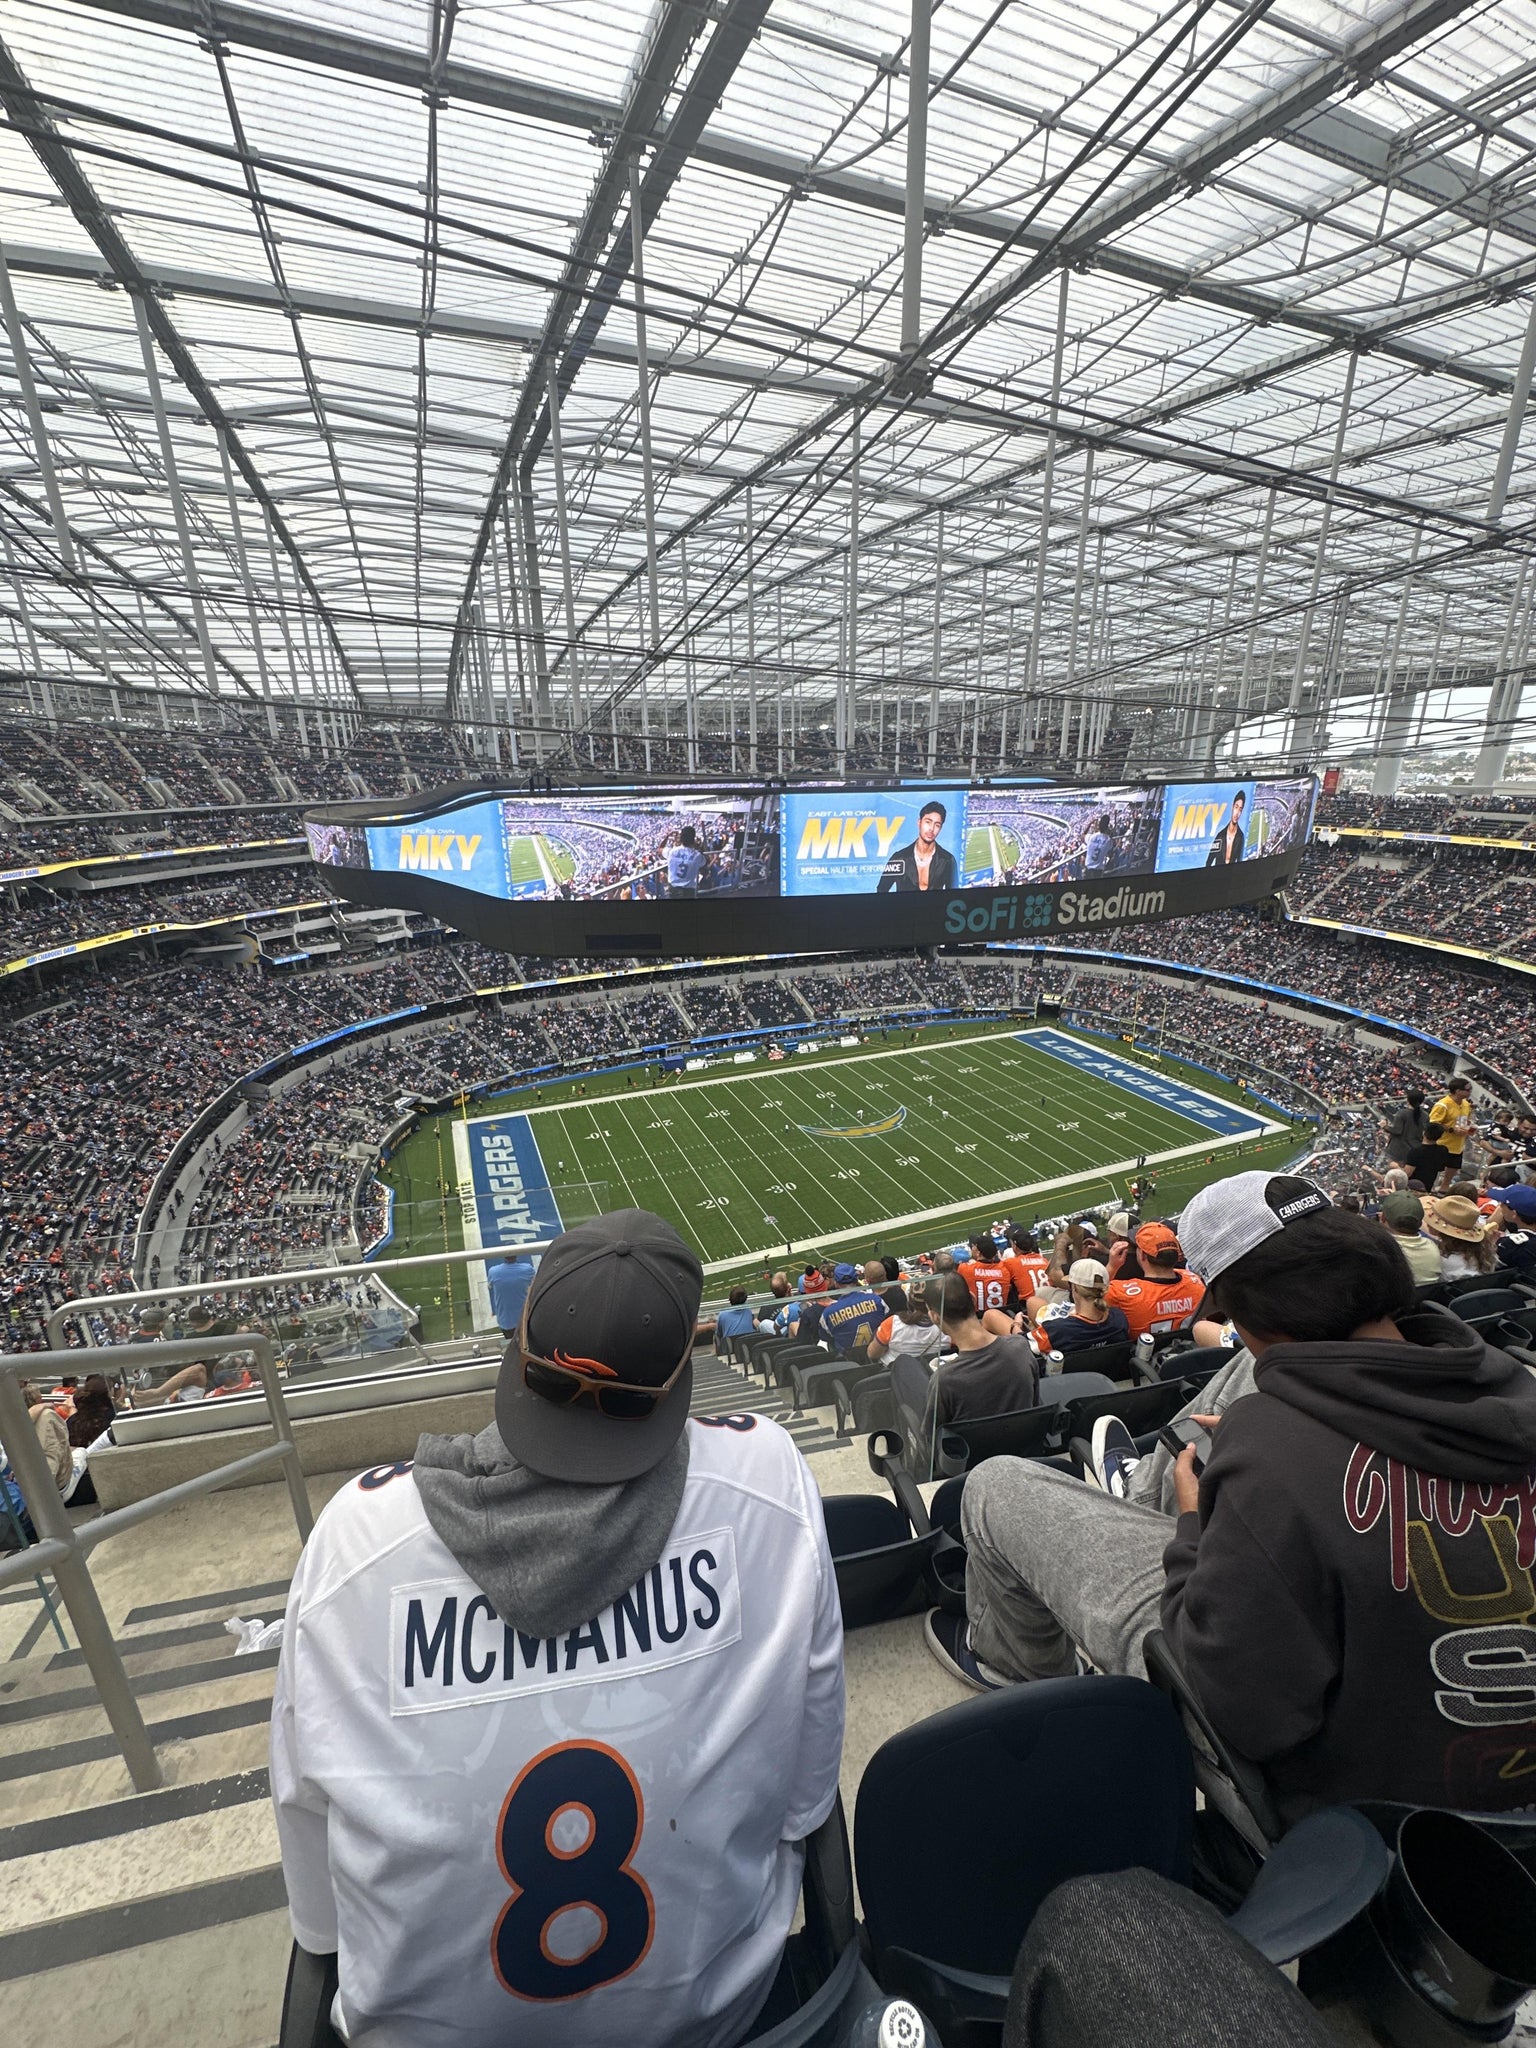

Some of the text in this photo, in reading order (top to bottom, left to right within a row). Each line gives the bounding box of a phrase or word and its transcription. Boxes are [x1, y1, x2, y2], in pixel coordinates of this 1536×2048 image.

[1167, 803, 1228, 841] MKY
[399, 834, 482, 871] MKY
[796, 816, 906, 860] MKY
[800, 865, 829, 876] SPECIAL
[944, 885, 1166, 934] SoFi Stadium
[815, 1090, 837, 1099] 50
[1039, 1040, 1227, 1119] LOS ANGELES
[463, 1202, 477, 1225] STOP
[1278, 1193, 1321, 1219] CHARGERS
[974, 1268, 1003, 1278] MANNING
[1028, 1269, 1050, 1291] 18
[975, 1280, 1004, 1311] 18
[1156, 1296, 1193, 1315] LINDSAY
[828, 1299, 878, 1327] HARBAUGH
[404, 1549, 721, 1687] MCMANUS
[490, 1738, 656, 2003] 8
[888, 2006, 916, 2036] RECYCLE BOTTLE
